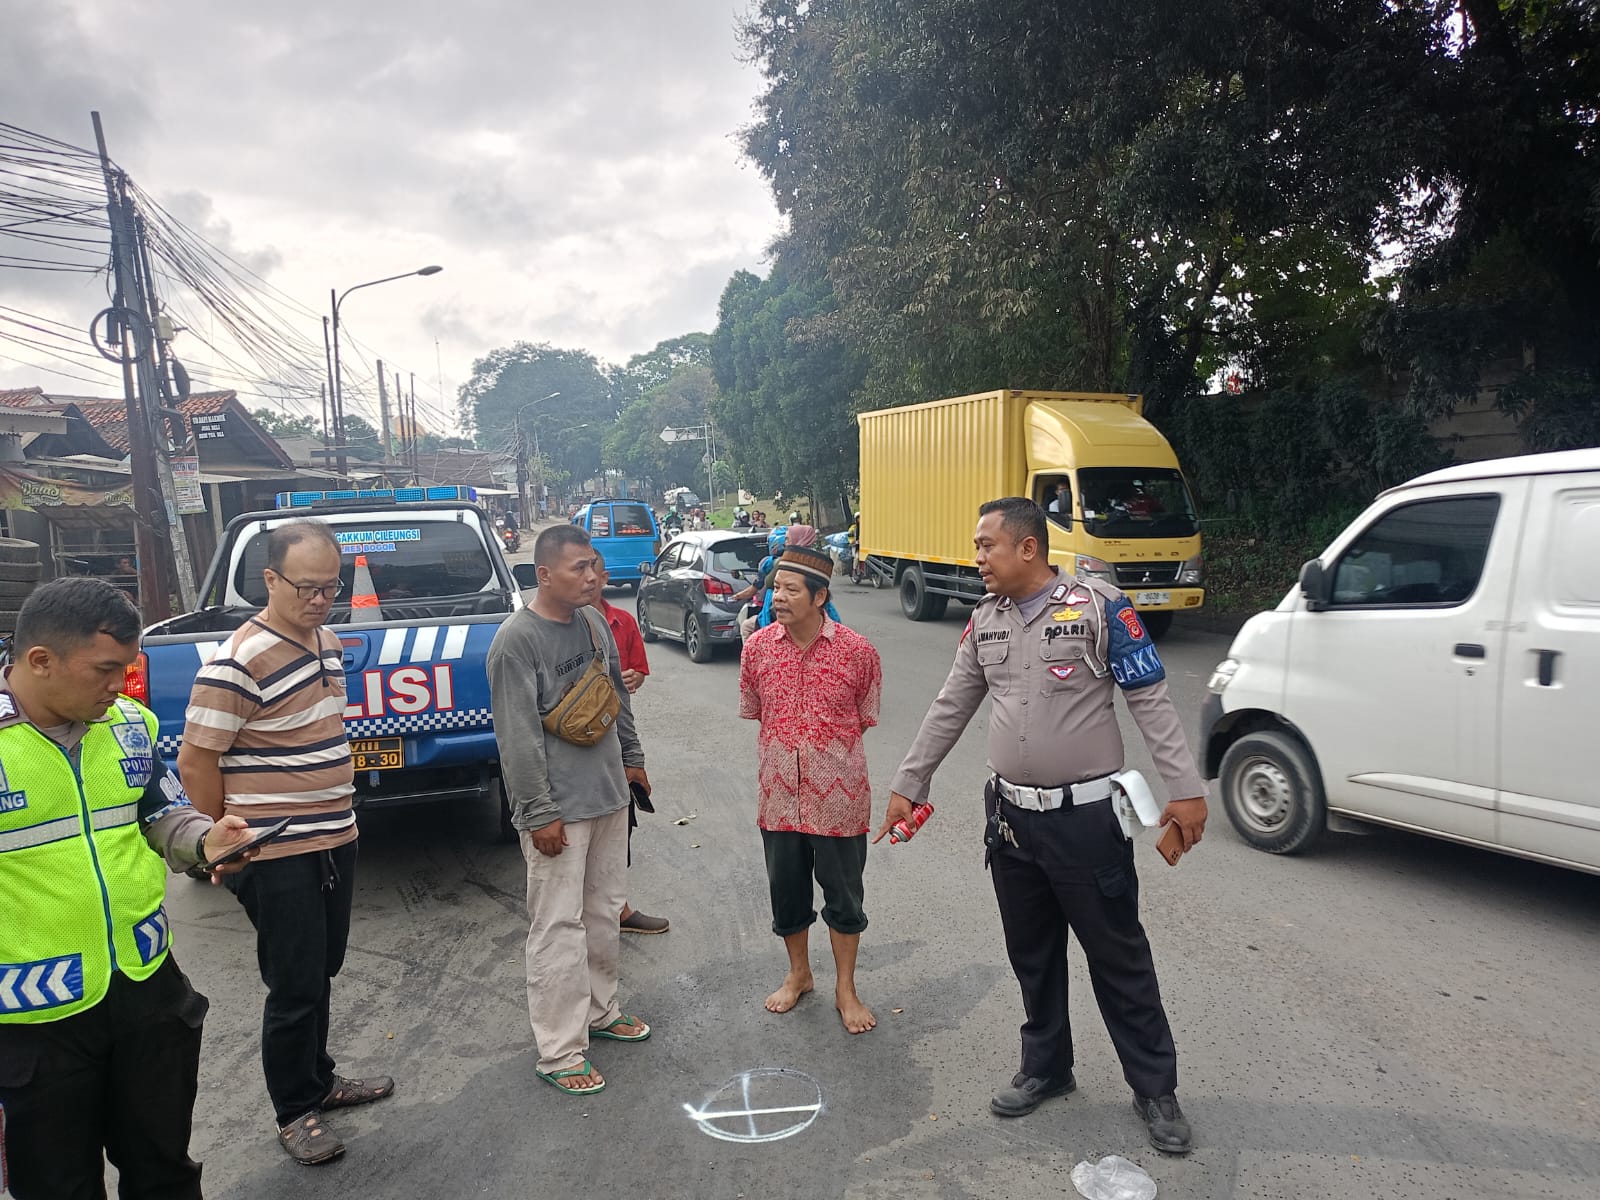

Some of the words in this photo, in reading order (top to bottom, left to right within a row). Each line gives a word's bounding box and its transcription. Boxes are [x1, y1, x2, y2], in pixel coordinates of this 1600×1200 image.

[374, 528, 421, 542] CILEUNGSI
[363, 542, 397, 553] BOGOR
[1045, 624, 1085, 637] POLRI
[380, 753, 398, 765] 30
